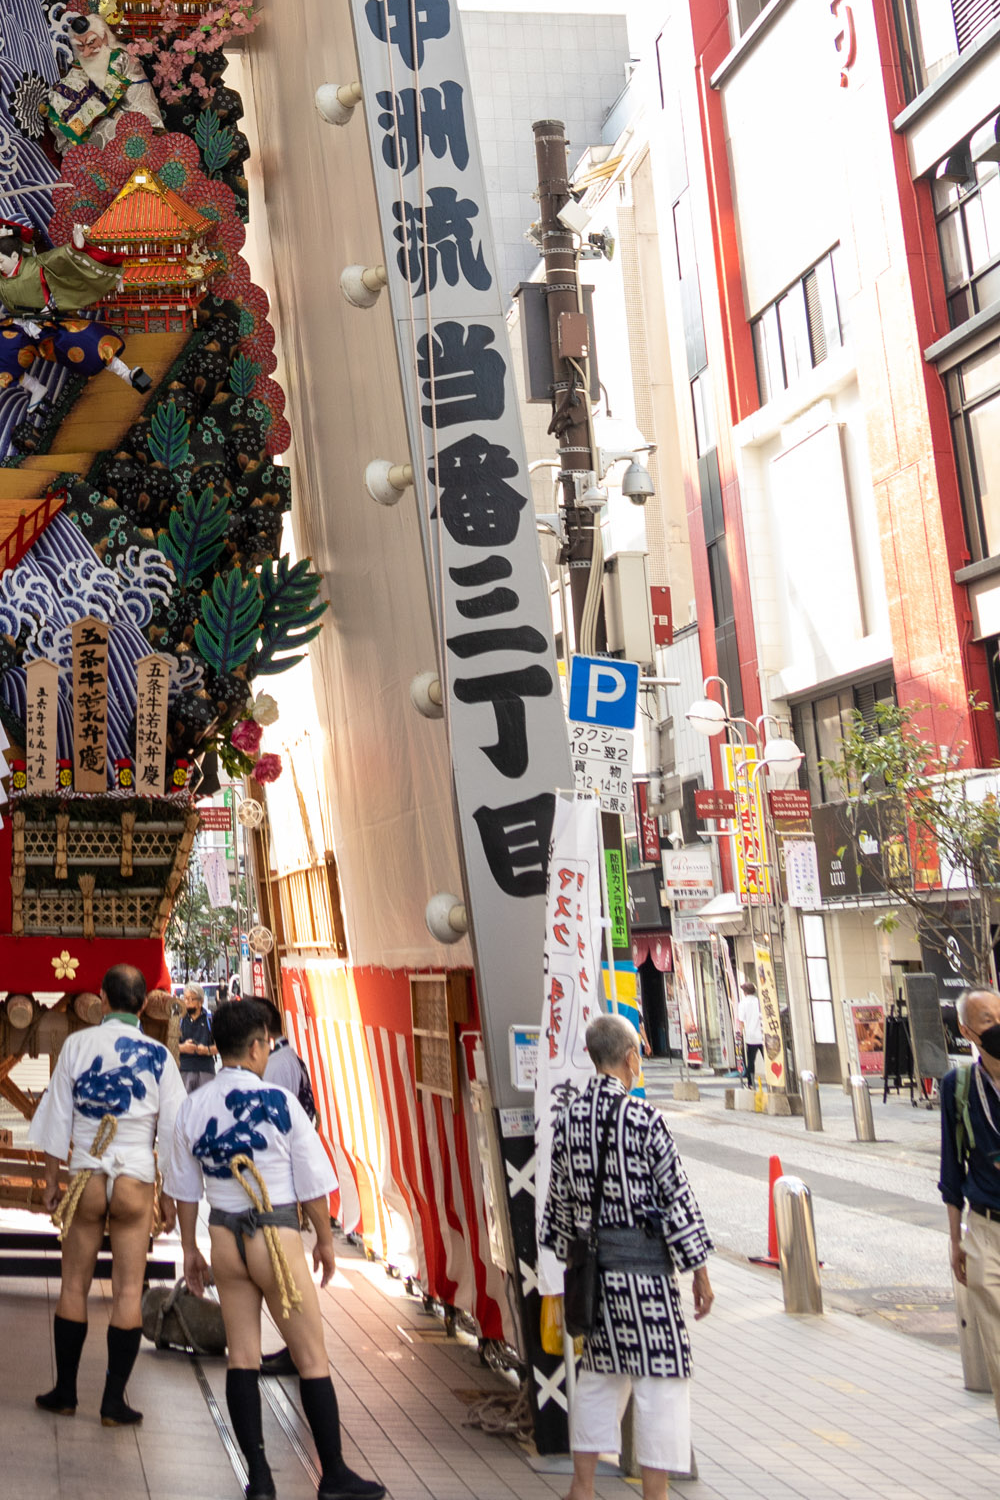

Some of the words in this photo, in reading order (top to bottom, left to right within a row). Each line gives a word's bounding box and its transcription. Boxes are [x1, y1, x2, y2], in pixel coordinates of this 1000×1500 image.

[586, 663, 627, 718] P
[141, 663, 165, 787] 五条牛若丸弁慶
[572, 727, 627, 744] タクシー
[600, 777, 628, 795] 14-16
[609, 853, 626, 937] 防犯カメラ作動中
[830, 871, 846, 886] LULU
[552, 867, 576, 947] マスク
